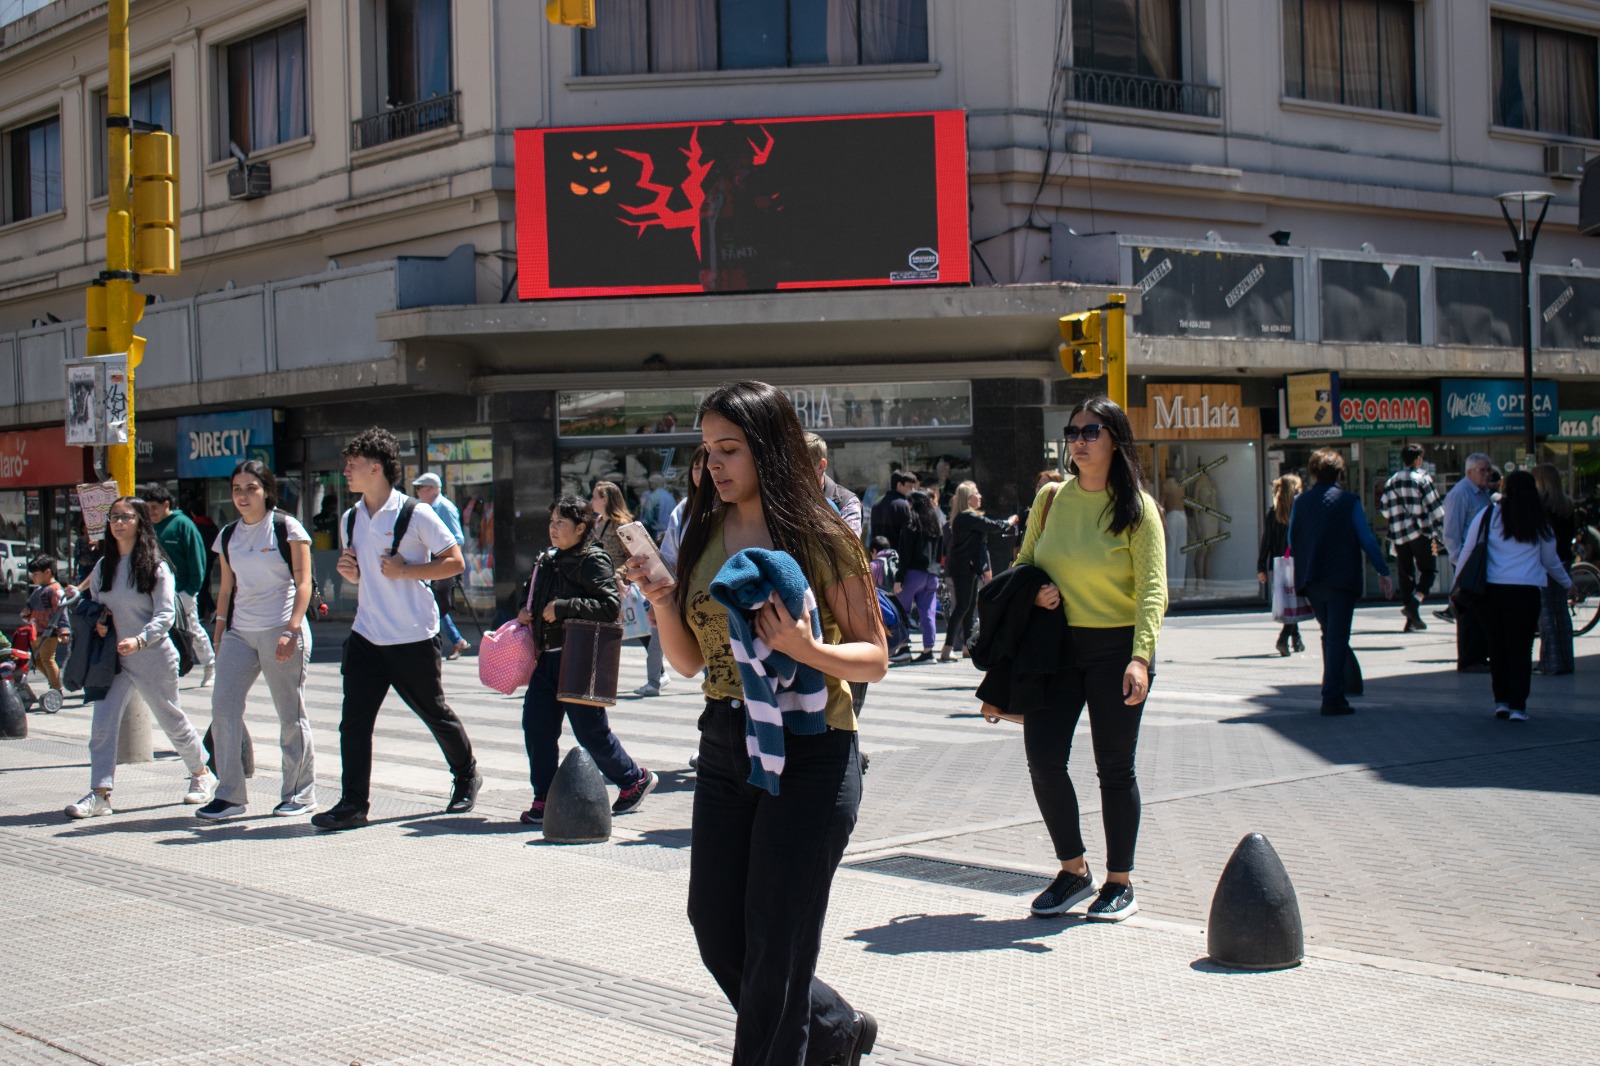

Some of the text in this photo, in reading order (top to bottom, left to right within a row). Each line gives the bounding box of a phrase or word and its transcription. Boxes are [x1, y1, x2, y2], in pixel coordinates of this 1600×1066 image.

[1138, 260, 1171, 294] PONIBLE
[1226, 264, 1264, 306] DISPONIBLE
[1152, 394, 1240, 429] Mulata
[1497, 394, 1552, 411] OPTCA
[1298, 427, 1341, 438] FOTOCOPIAS
[1557, 415, 1587, 436] laza
[189, 428, 251, 460] DIRECTV
[0, 451, 23, 478] laro
[692, 590, 711, 611] Fer
